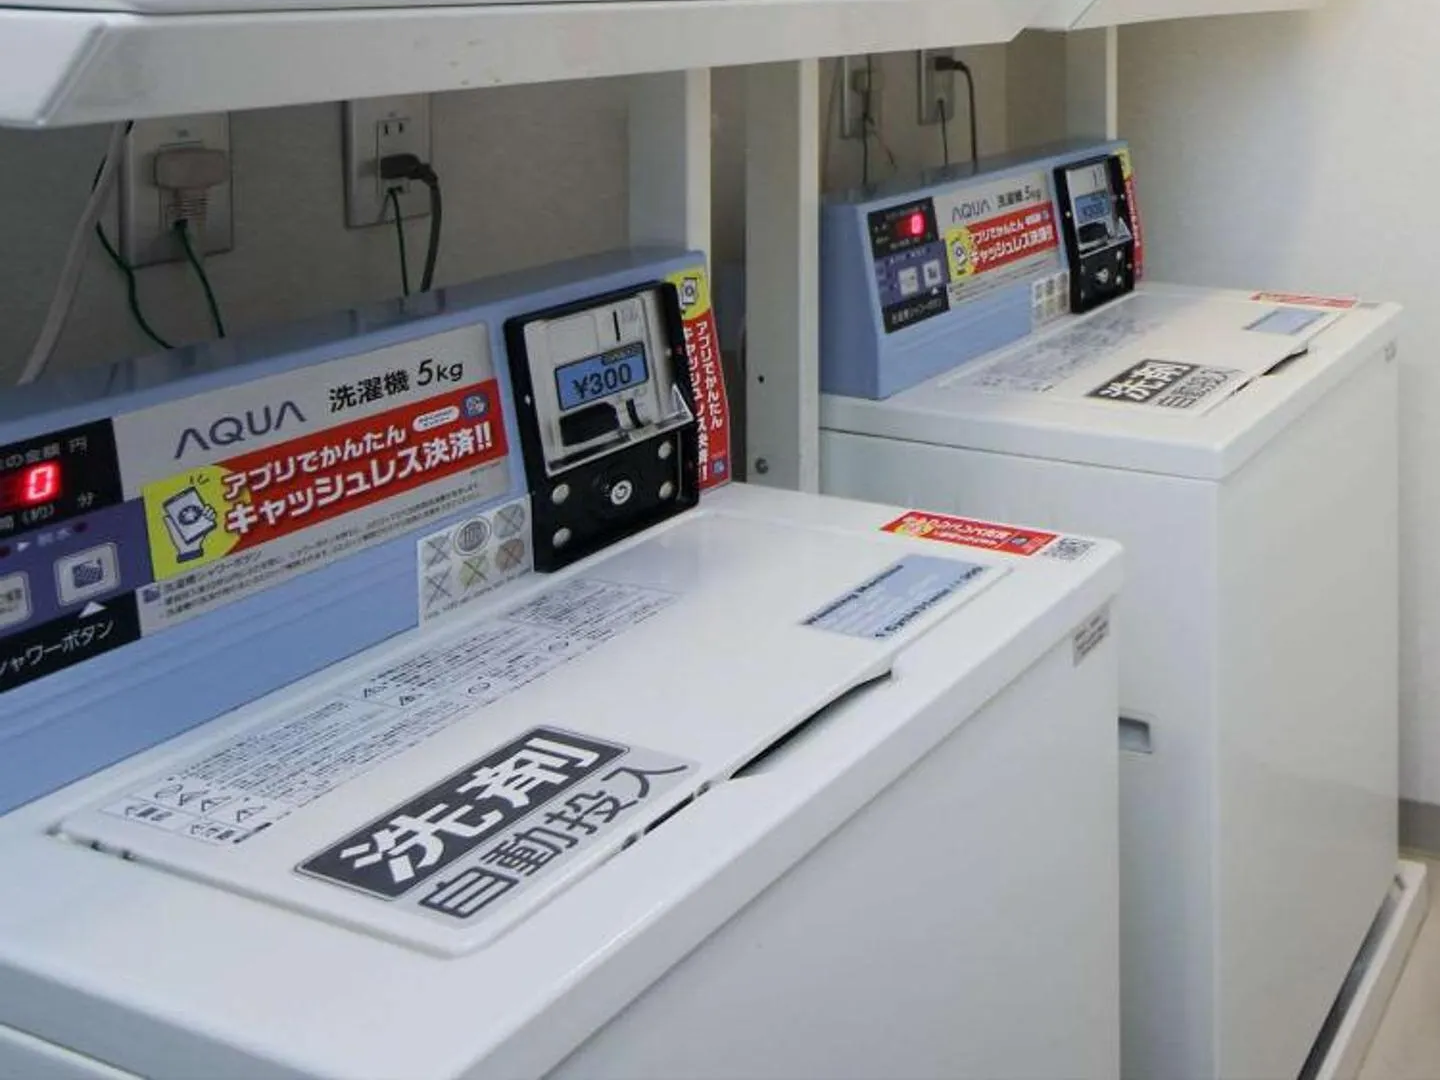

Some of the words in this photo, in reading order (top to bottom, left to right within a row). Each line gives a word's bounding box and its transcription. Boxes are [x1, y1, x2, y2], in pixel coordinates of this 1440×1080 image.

[952, 200, 991, 223] AQUA
[572, 363, 632, 400] ¥300
[1100, 360, 1191, 402] 洗剤
[174, 400, 307, 460] AQUA
[328, 369, 410, 413] 洗濯機
[416, 359, 464, 387] 5kg
[68, 435, 88, 454] 円
[222, 424, 407, 500] アプリでかんたん
[26, 464, 55, 501] 0
[225, 421, 494, 534] キャッシュレス決済!!
[77, 491, 96, 509] 分
[340, 736, 601, 884] 洗剤
[418, 764, 690, 919] 自動投入
